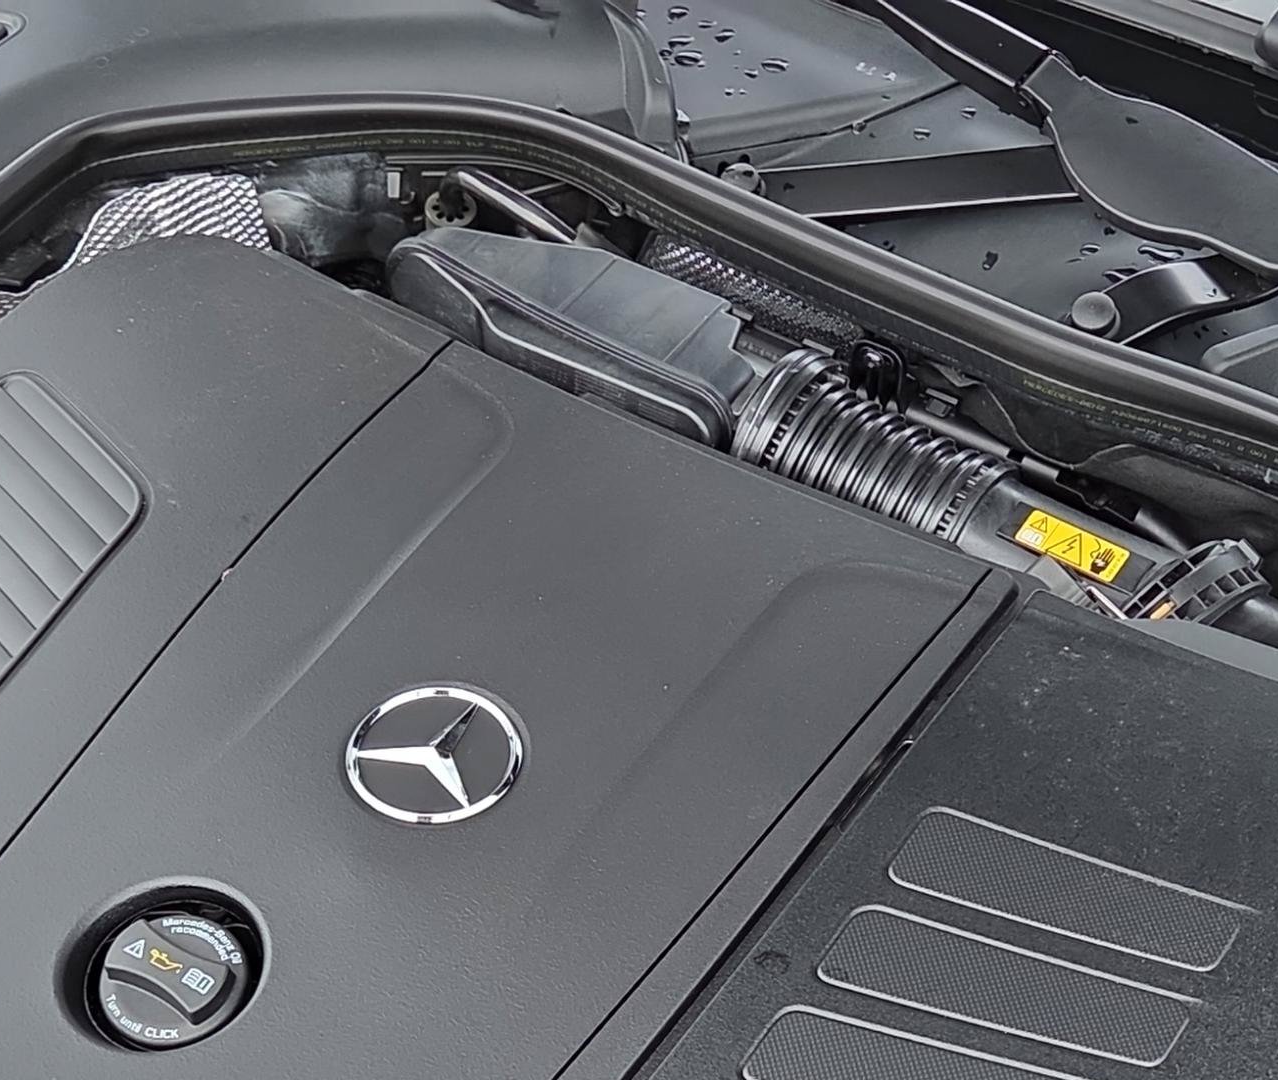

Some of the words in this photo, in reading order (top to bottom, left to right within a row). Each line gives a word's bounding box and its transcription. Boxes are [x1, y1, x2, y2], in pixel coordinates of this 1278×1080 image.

[162, 918, 235, 951] Mercedes-Benz
[170, 926, 231, 962] recommended
[105, 993, 121, 1018] Turn
[120, 1016, 144, 1033] until
[144, 1026, 180, 1040] CLICK
